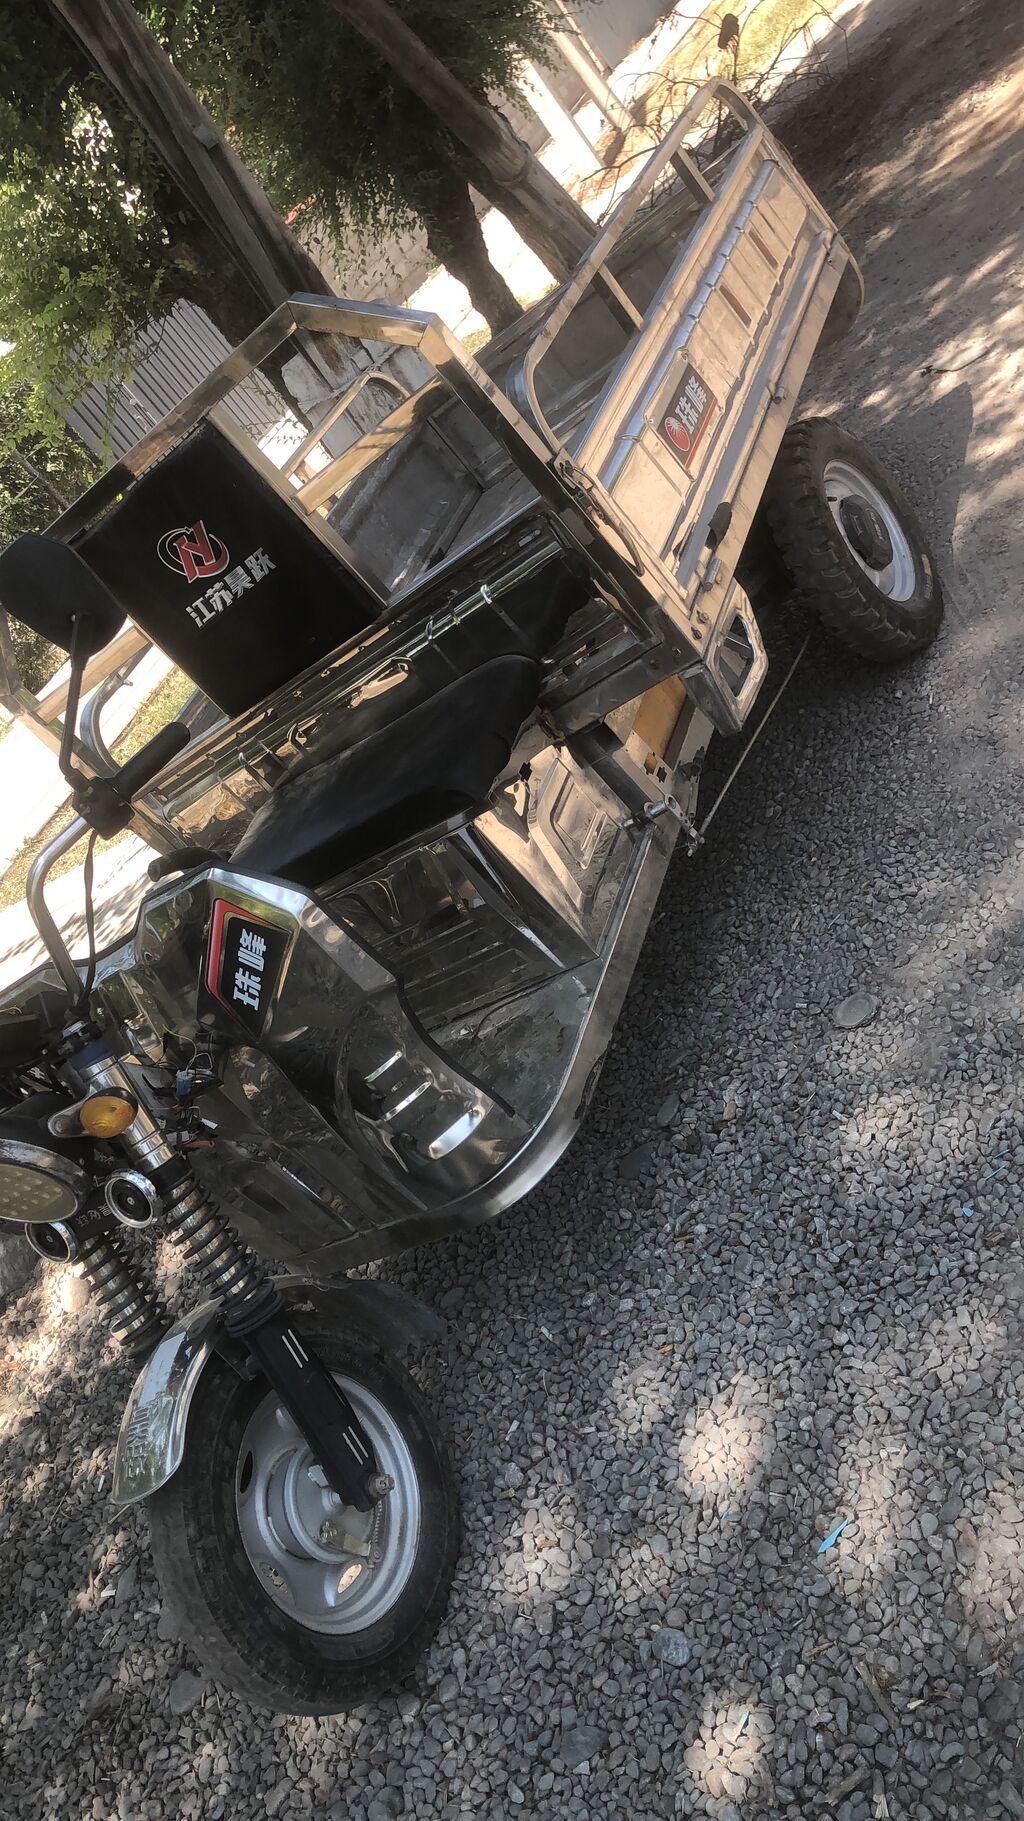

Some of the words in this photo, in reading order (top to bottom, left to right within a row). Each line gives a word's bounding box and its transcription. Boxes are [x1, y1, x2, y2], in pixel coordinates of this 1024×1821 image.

[674, 375, 708, 434] 珠峰
[185, 546, 277, 629] 江苏昊跃
[232, 927, 267, 1011] 珠峰
